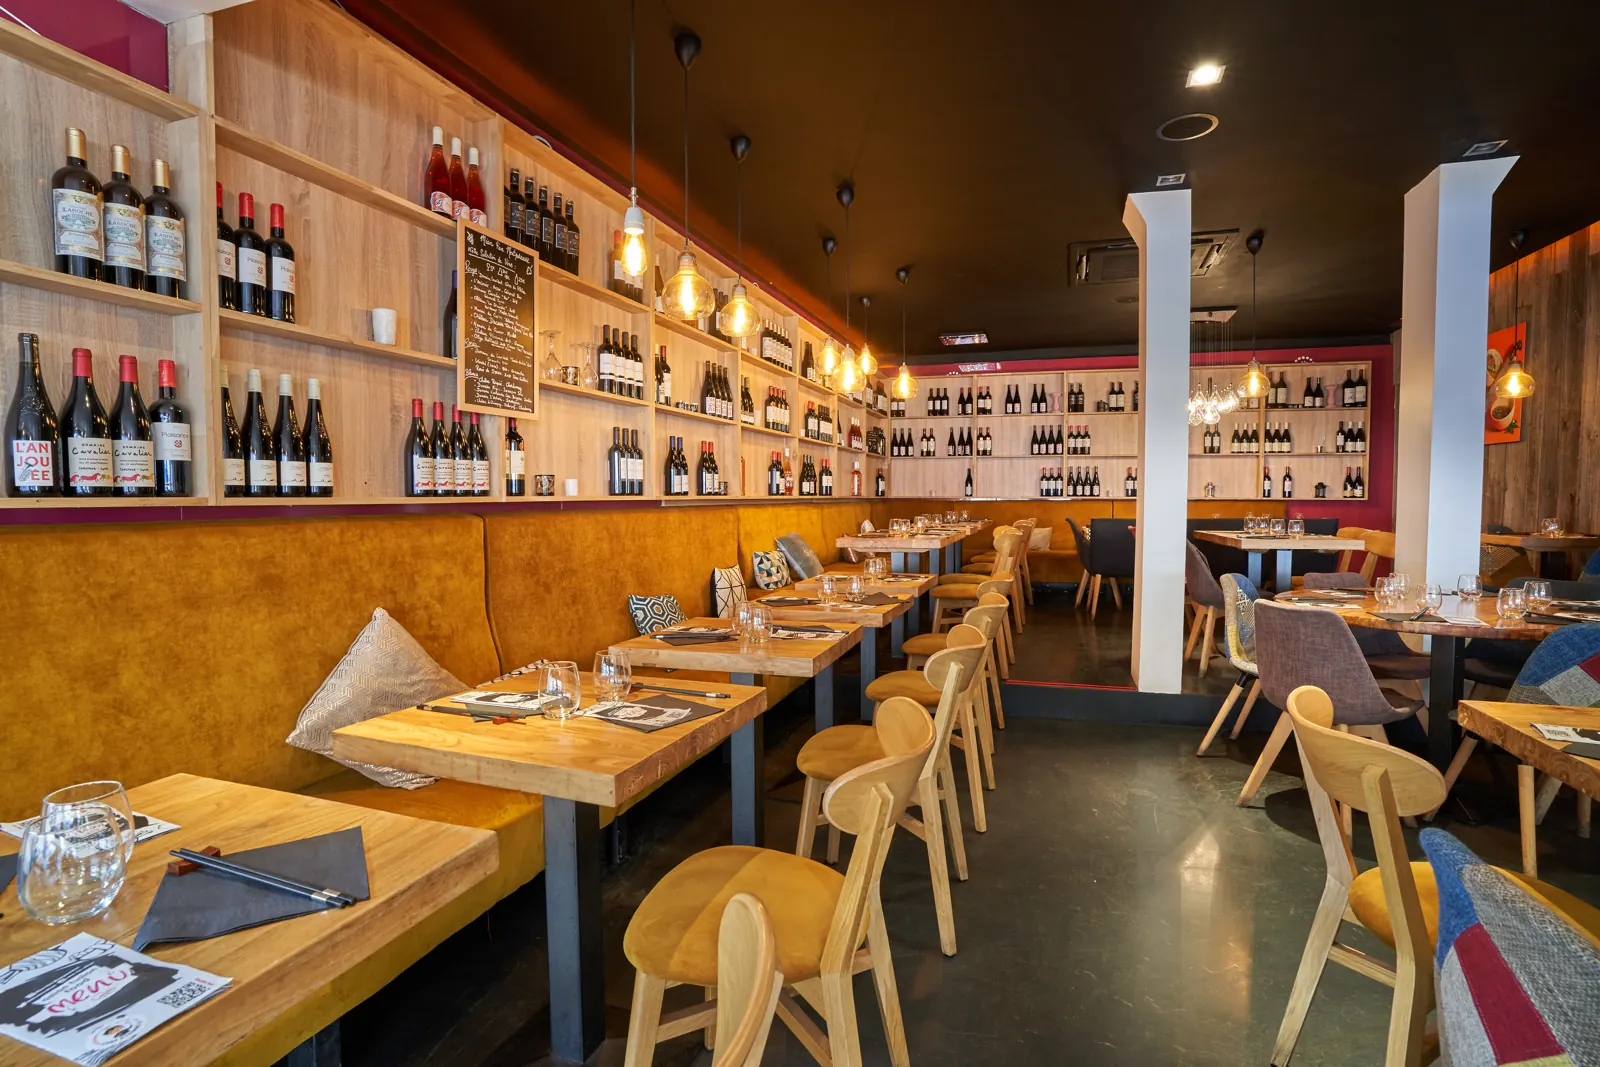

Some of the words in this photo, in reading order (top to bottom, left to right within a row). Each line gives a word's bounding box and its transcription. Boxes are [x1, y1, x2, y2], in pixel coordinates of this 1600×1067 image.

[16, 442, 49, 453] L'AN
[72, 446, 112, 455] Cavalier
[114, 448, 153, 457] Cavalier
[17, 456, 50, 467] JOU
[31, 469, 51, 481] ÉE
[47, 970, 128, 1013] menu
